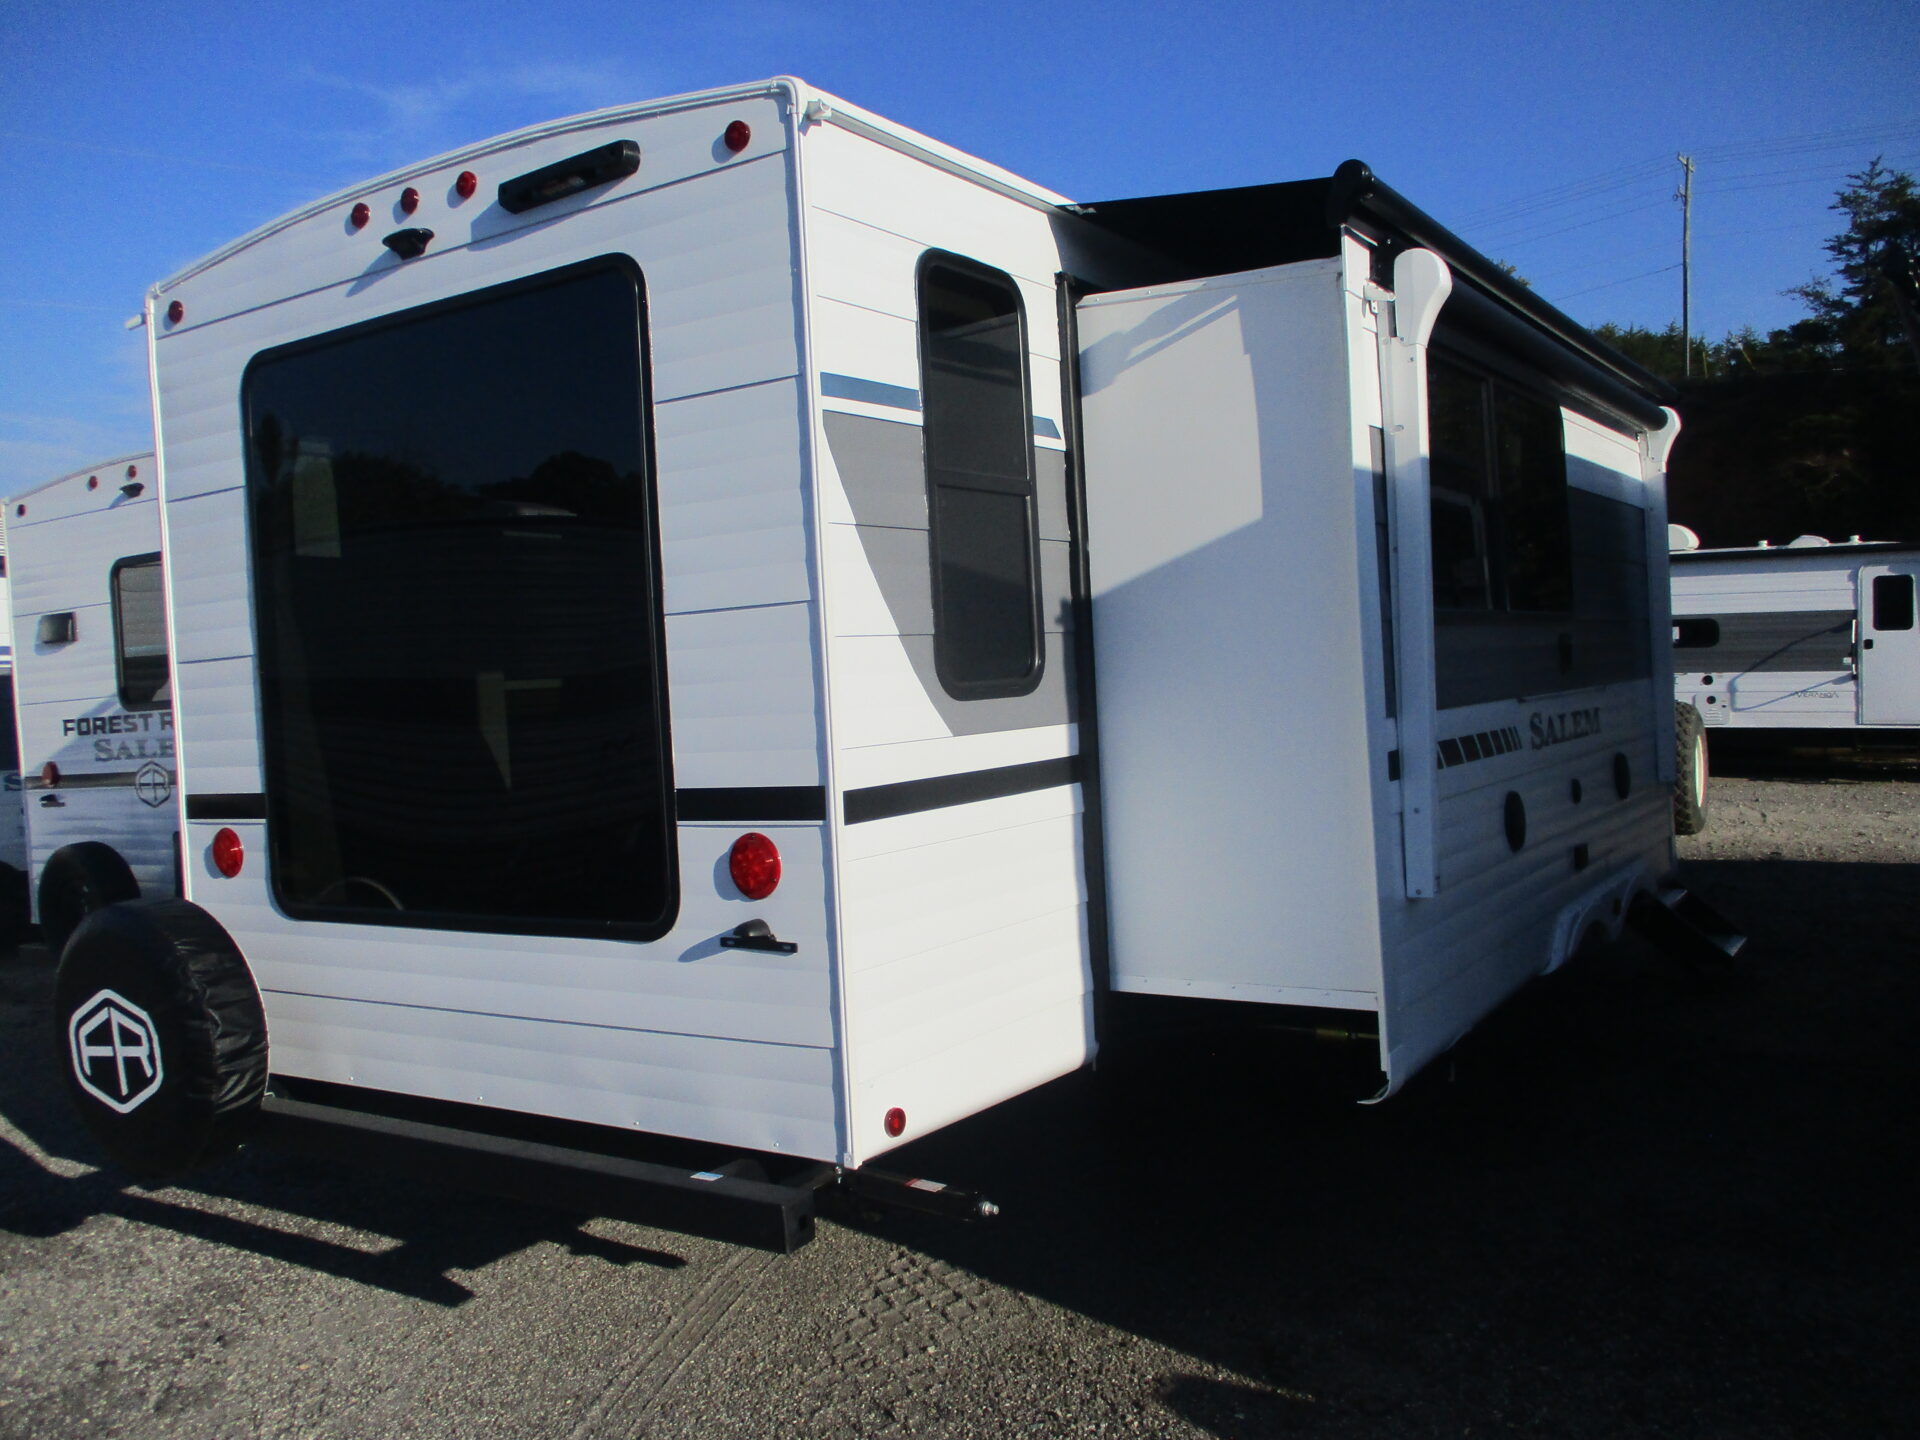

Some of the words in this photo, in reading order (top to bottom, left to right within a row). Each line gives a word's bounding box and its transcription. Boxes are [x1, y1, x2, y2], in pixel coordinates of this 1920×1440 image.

[63, 713, 153, 736] FOREST
[1530, 707, 1601, 750] SALEM
[94, 738, 176, 761] SALE
